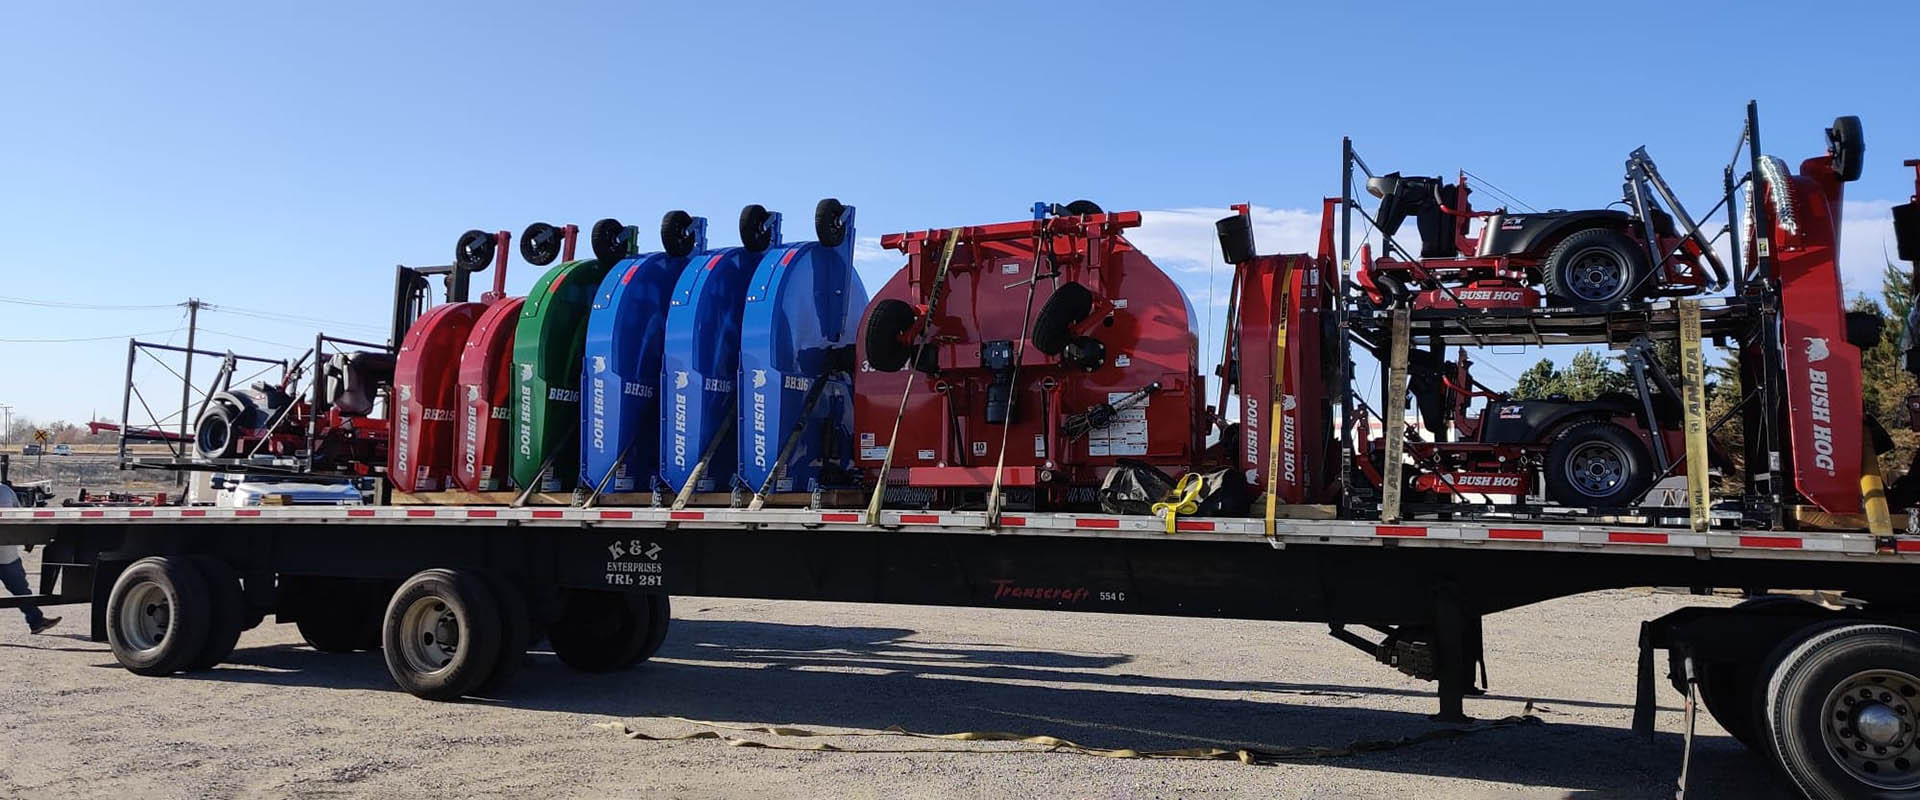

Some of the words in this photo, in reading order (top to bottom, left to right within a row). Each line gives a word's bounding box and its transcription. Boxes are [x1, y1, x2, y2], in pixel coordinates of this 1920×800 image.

[1458, 290, 1491, 300] BUSH
[1492, 290, 1520, 301] HOG
[548, 387, 580, 403] BH216
[593, 378, 604, 416] BUSH
[624, 382, 654, 398] BH316
[705, 378, 731, 393] BH316
[784, 375, 810, 391] BH316
[1809, 367, 1831, 424] BUSH
[521, 385, 531, 423] BUSH
[675, 393, 686, 433] BUSH
[753, 393, 765, 432] BUSH
[1247, 398, 1258, 428] HOG
[400, 406, 409, 441] BUSH
[467, 406, 477, 443] BUSH
[520, 423, 531, 456] HOG
[593, 417, 604, 449] HOG
[1284, 415, 1295, 450] BUSH
[398, 443, 408, 471] HOG
[466, 444, 476, 474] HOG
[675, 433, 685, 467] HOG
[754, 433, 766, 468] HOG
[1247, 429, 1258, 465] BUSH
[1813, 424, 1834, 472] HOG
[1284, 450, 1296, 482] HOG
[1457, 476, 1491, 486] BUSH
[1492, 477, 1518, 487] HOG
[608, 540, 626, 560] K
[629, 540, 642, 555] &
[644, 542, 663, 560] Z
[605, 574, 633, 585] TRL
[639, 575, 662, 586] 281
[607, 562, 662, 573] ENTERPRISES
[991, 578, 1089, 602] Transcraft
[1100, 592, 1116, 601] 554
[1118, 592, 1125, 601] C
